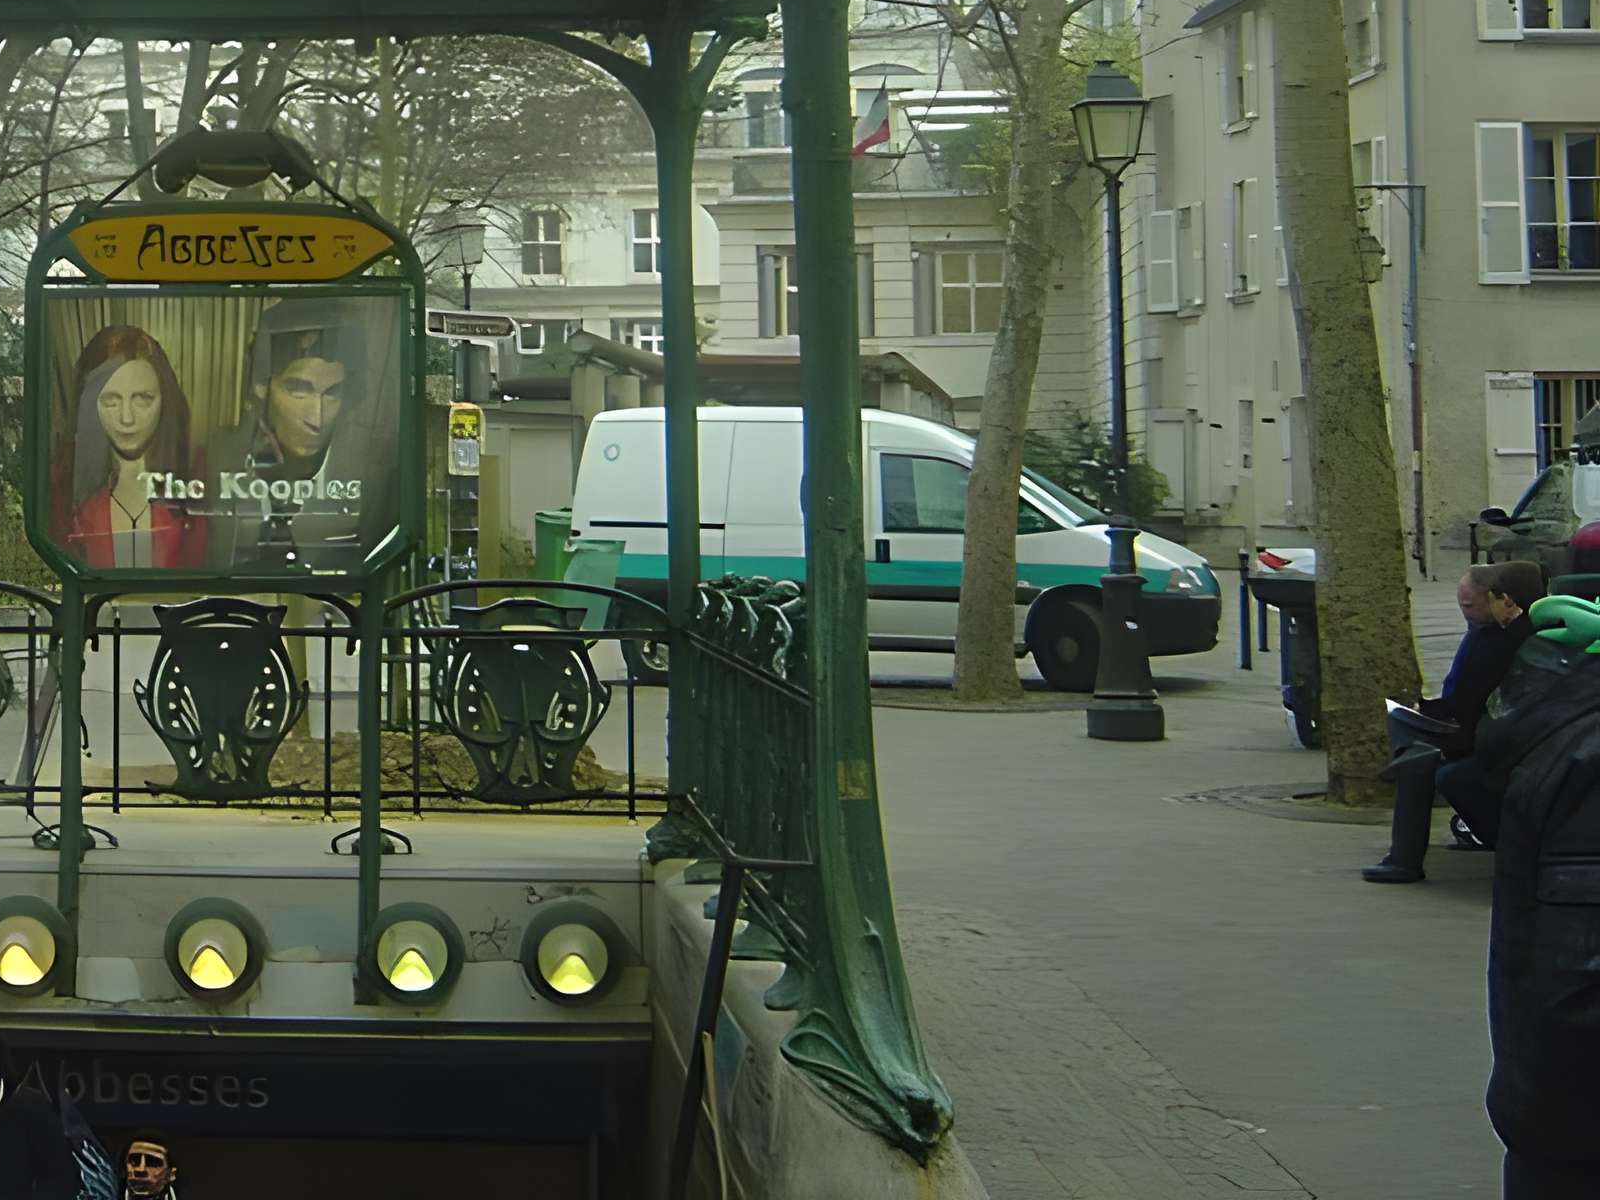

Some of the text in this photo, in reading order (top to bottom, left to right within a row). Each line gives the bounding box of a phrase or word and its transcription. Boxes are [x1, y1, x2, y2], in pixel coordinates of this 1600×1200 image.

[137, 472, 362, 504] The Kooples
[13, 1058, 269, 1108] Abbesses
